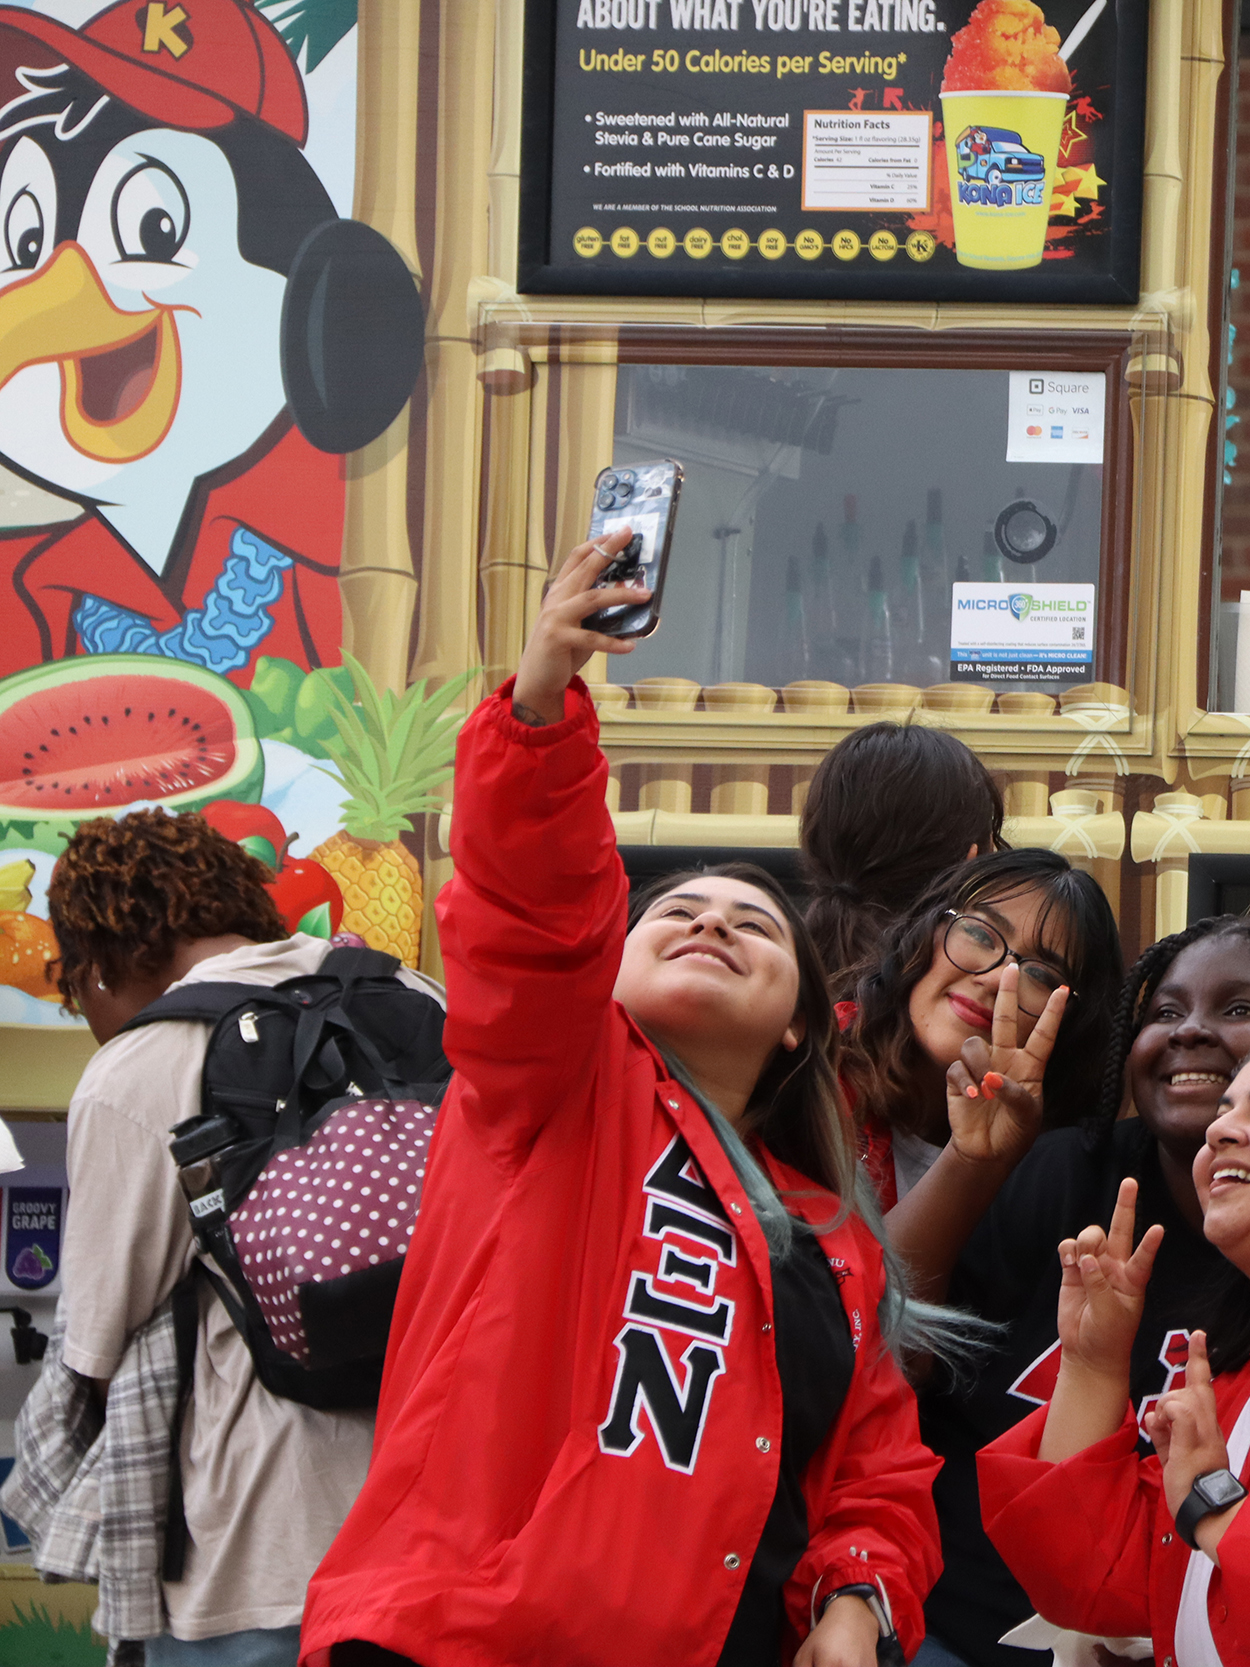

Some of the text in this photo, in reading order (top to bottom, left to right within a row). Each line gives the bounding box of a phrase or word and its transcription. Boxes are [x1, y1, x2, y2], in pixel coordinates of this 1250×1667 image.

[577, 0, 947, 33] ABOUT WHAT YOU'RE EATING.
[141, 2, 189, 59] K
[579, 48, 645, 72] Under
[651, 50, 679, 73] 50
[685, 49, 771, 74] Calories
[776, 54, 811, 79] per
[595, 111, 790, 128] Sweetened with All-Natural
[814, 119, 890, 130] Nutrition Facts
[595, 131, 777, 150] Stevia & Pure Cane Sugar
[594, 162, 795, 179] Fortified with Vitamins C & D
[957, 181, 1045, 208] KONA ICE
[593, 203, 602, 211] WE
[736, 205, 777, 213] ASSOCIATION
[1048, 381, 1090, 395] Square
[1072, 407, 1090, 415] VISA
[958, 599, 1087, 612] MICRO SHIELD
[957, 664, 1086, 674] EPA Registered FDA Approved
[13, 1202, 57, 1215] GROOVY
[12, 1215, 56, 1230] GRAPE
